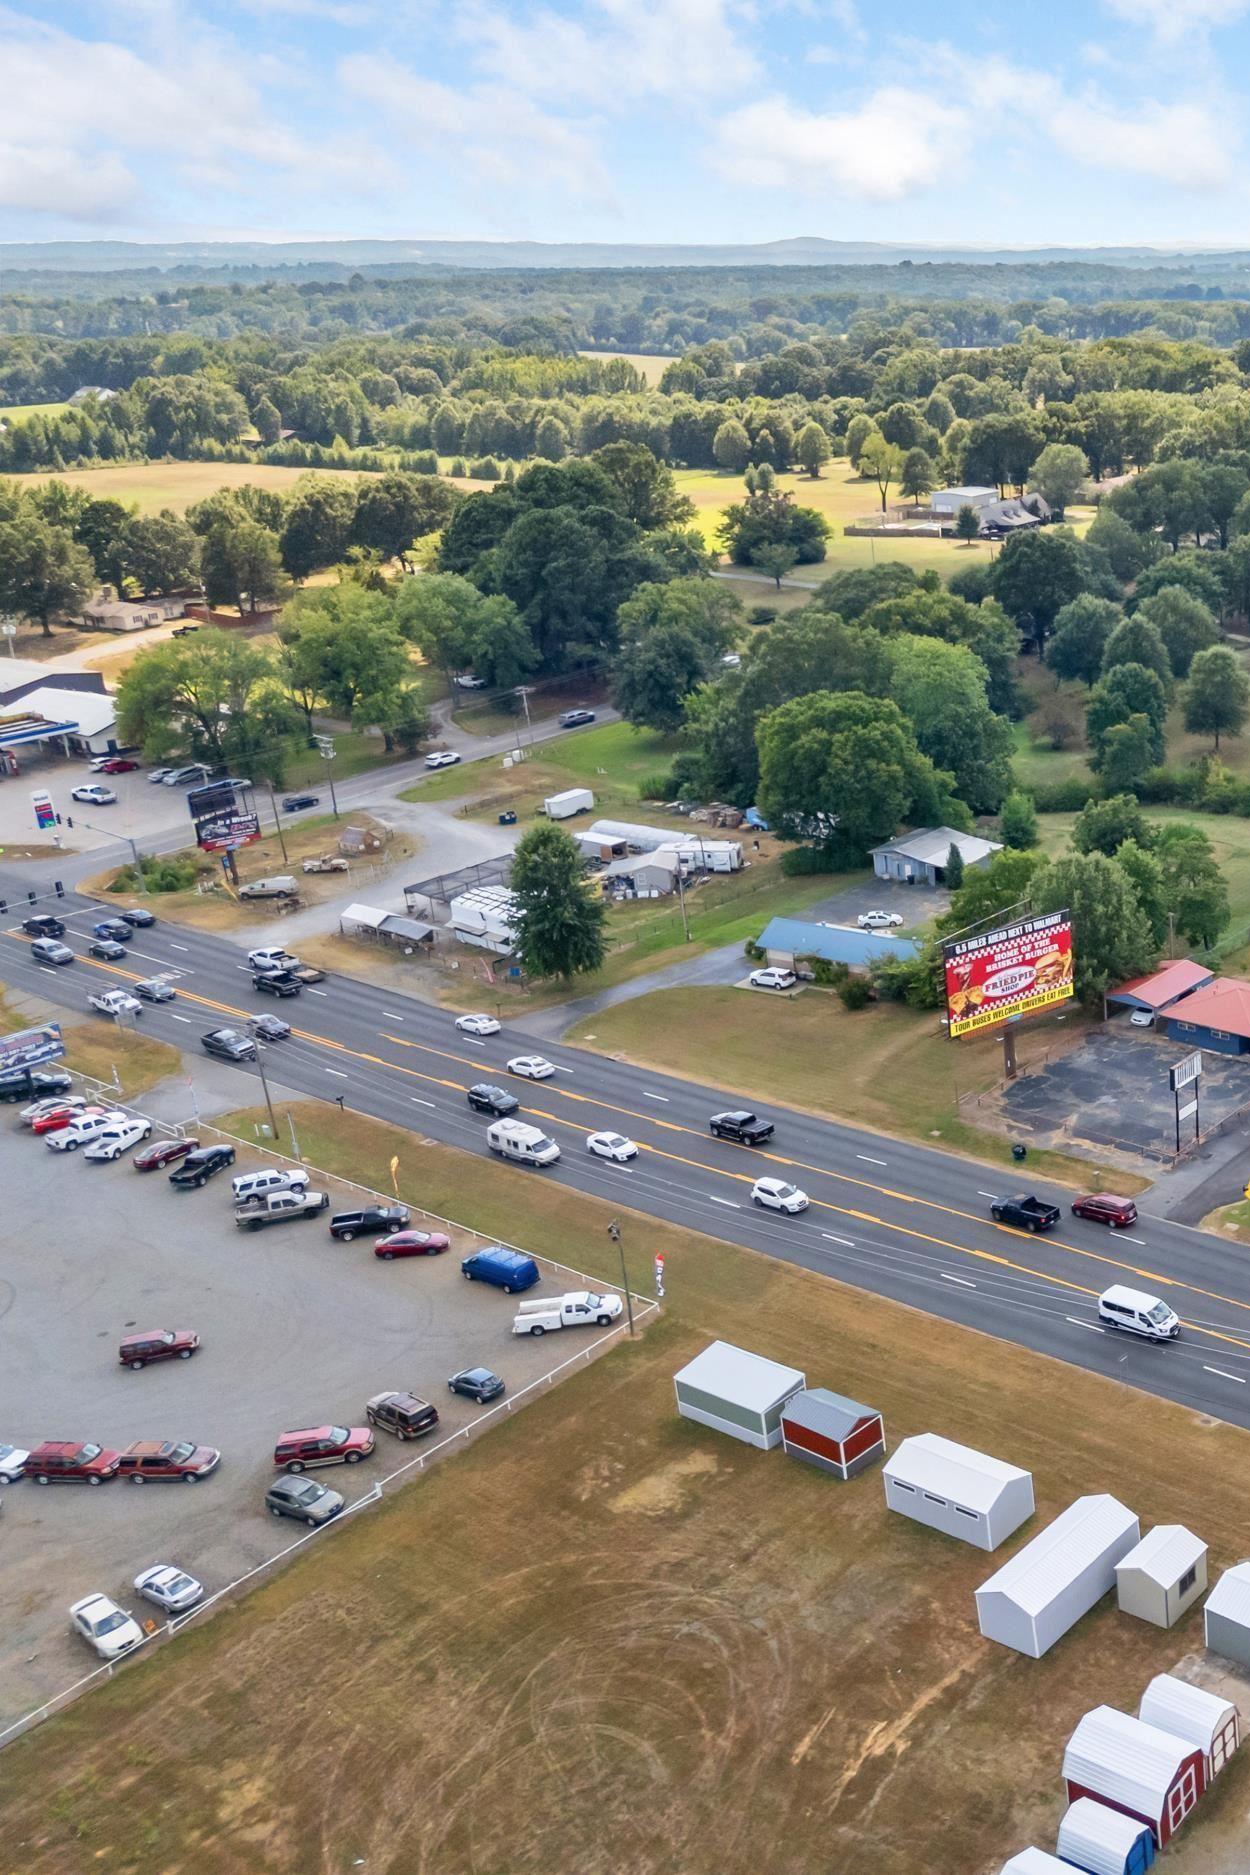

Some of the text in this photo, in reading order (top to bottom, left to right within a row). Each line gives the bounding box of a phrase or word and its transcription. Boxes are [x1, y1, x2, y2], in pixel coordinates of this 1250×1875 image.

[967, 937, 987, 951] MILES
[987, 930, 1007, 945] AHEAD
[1007, 926, 1024, 940] NEXT
[1024, 922, 1033, 934] TO
[985, 954, 1023, 973] BRISKET
[1024, 944, 1059, 961] BURGER
[994, 938, 1051, 962] HOME OF THE
[984, 975, 1018, 993] FRIED
[1018, 969, 1035, 982] PIE
[1001, 982, 1019, 994] SHOP
[955, 986, 1071, 1033] TOUR BUSES WELCOME DRIVERS EAT FREE
